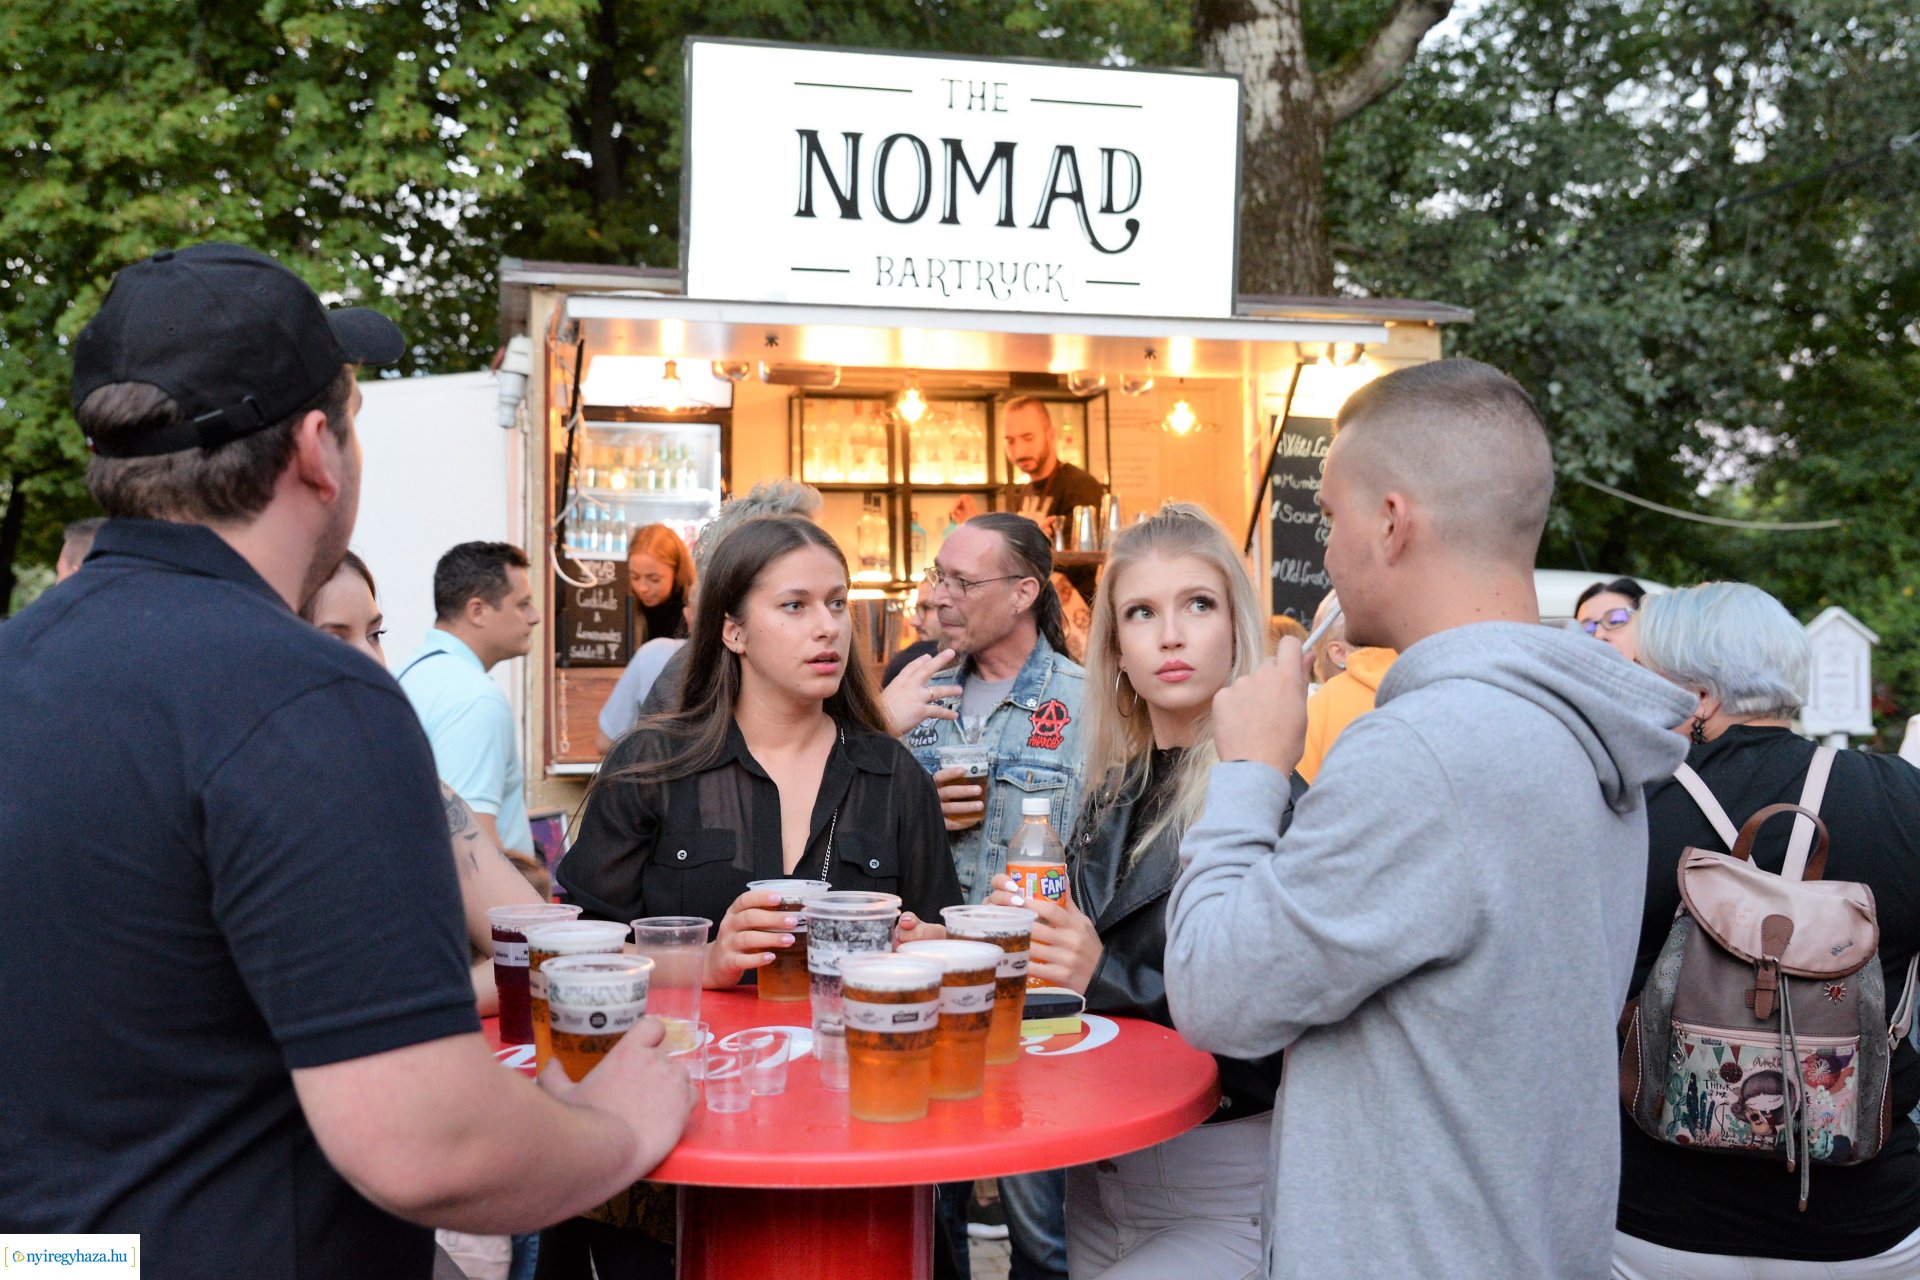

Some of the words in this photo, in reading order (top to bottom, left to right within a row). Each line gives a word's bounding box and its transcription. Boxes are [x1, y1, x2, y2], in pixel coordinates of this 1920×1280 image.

[940, 78, 1009, 112] THE
[794, 128, 1143, 255] NOMAD
[875, 255, 1070, 303] BARTRUCK
[1040, 875, 1066, 895] FANT
[1702, 1079, 1733, 1092] THINK
